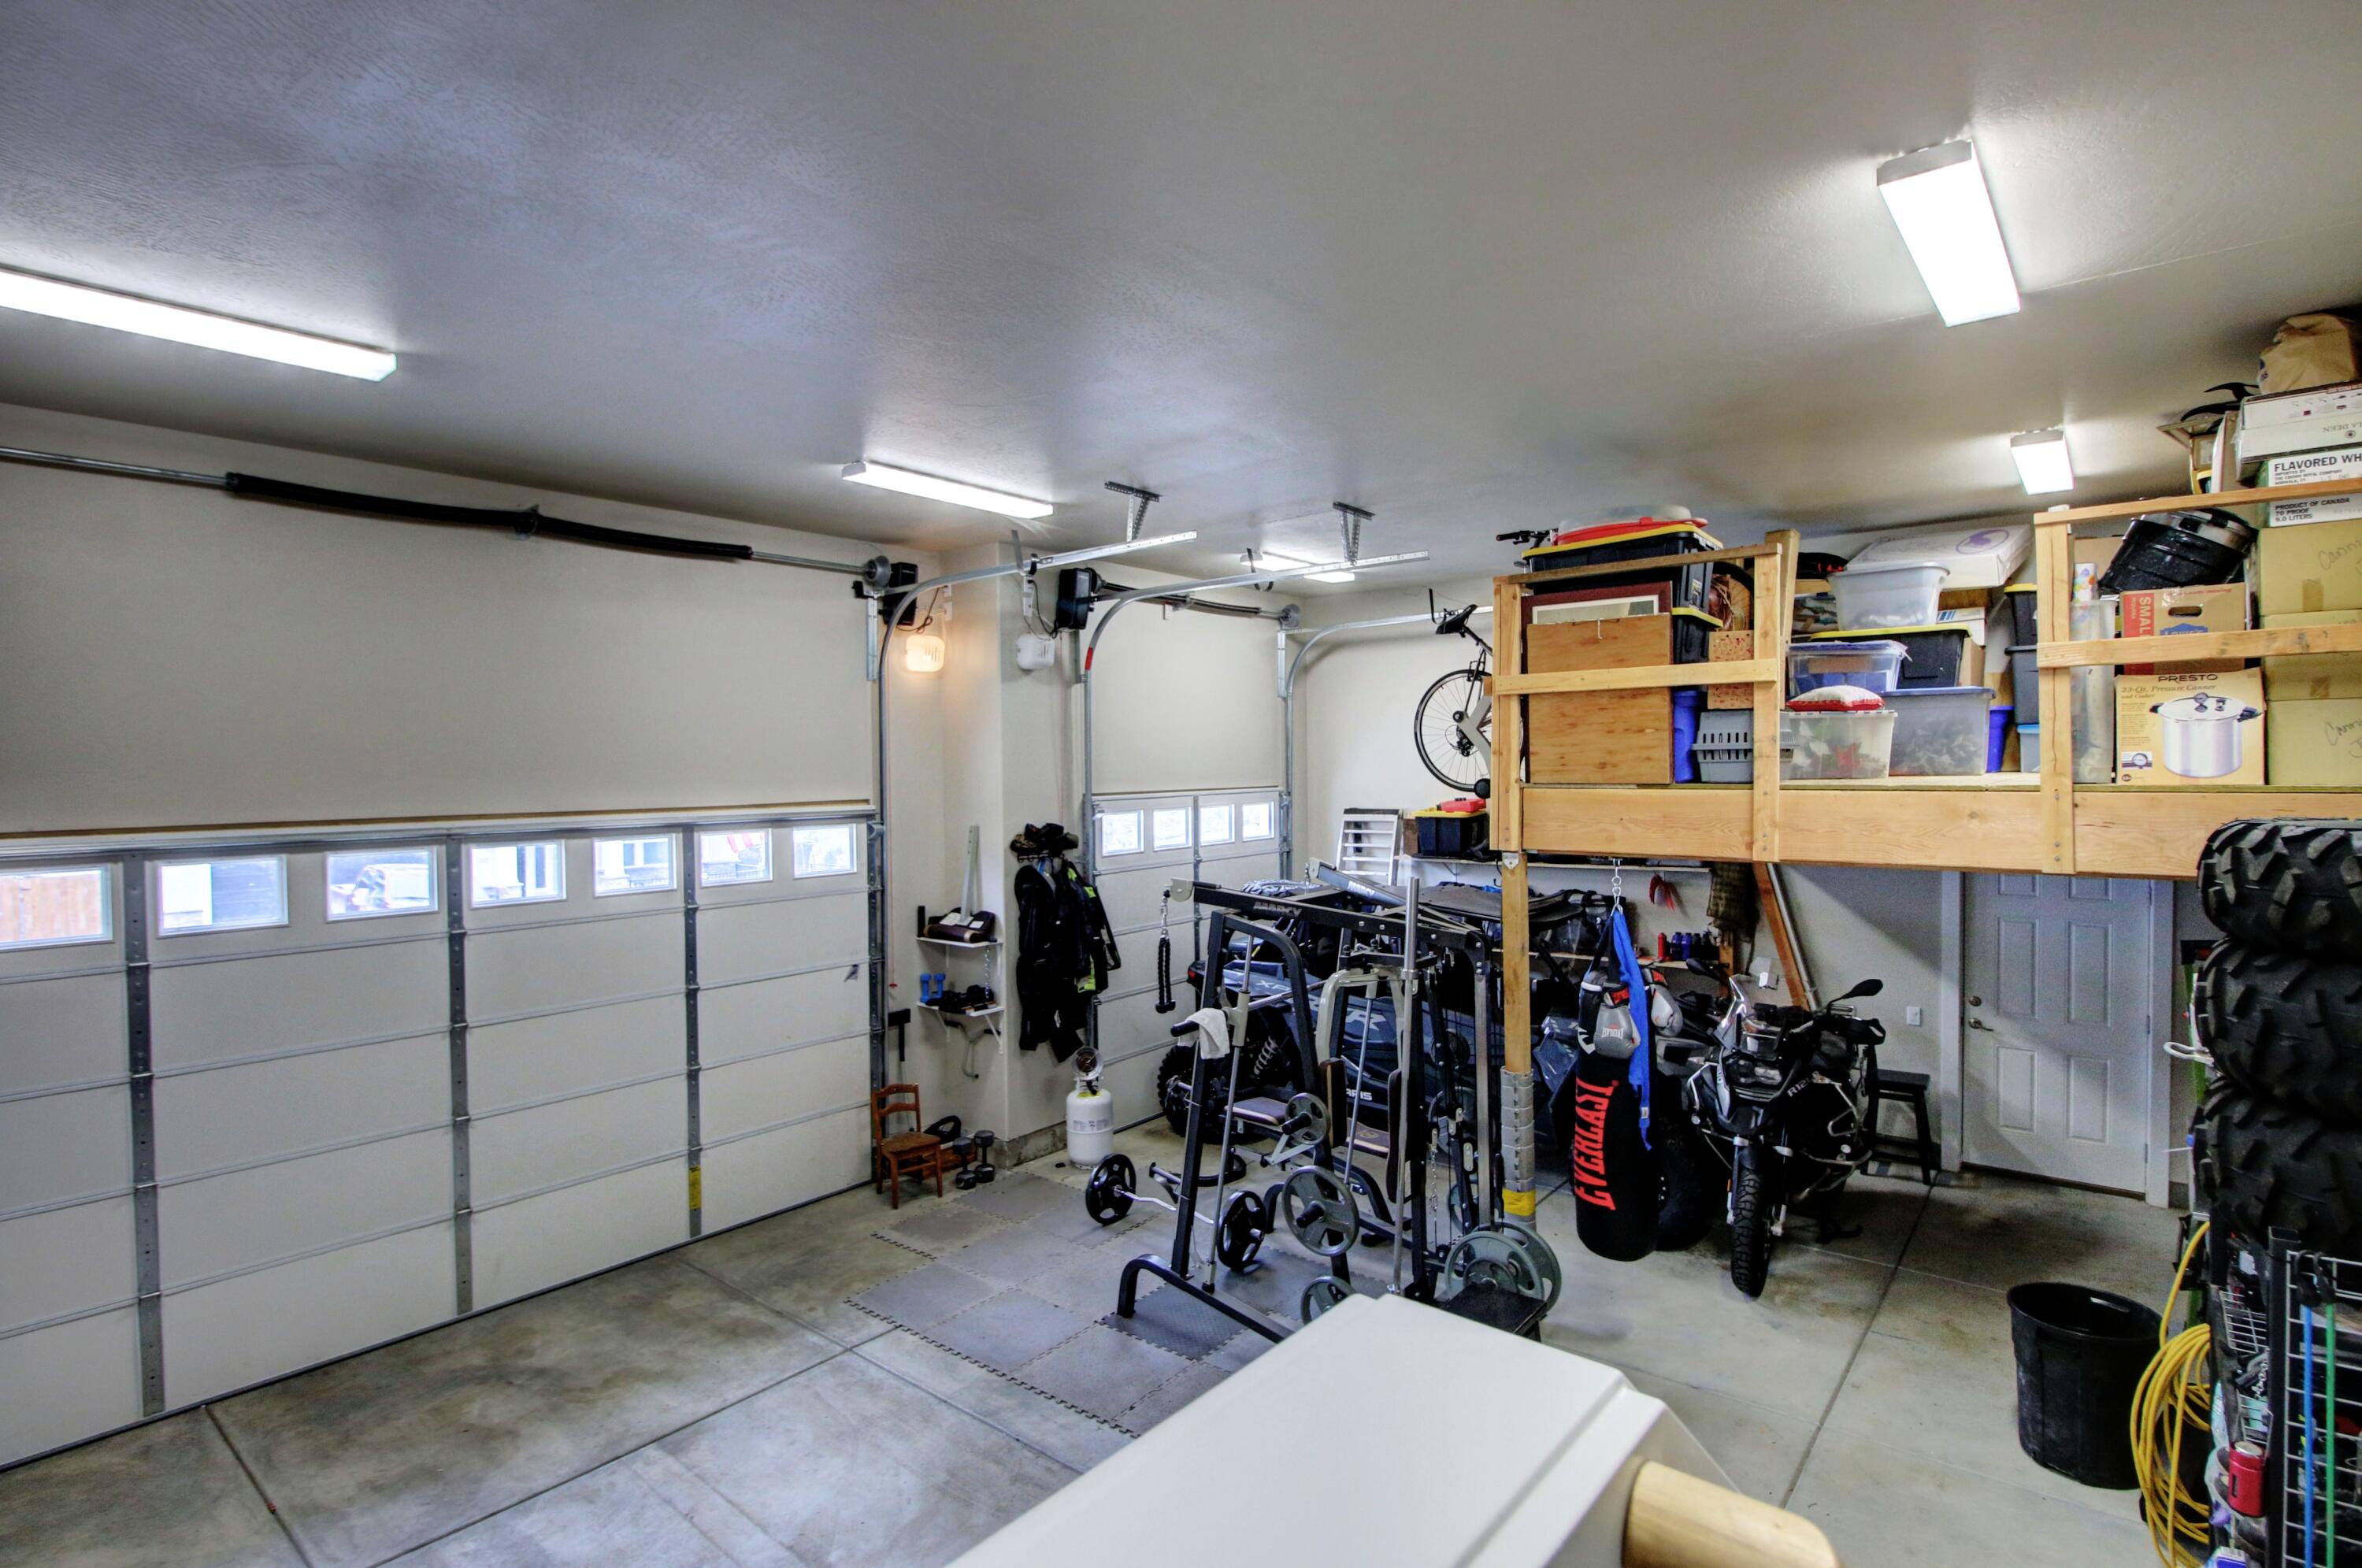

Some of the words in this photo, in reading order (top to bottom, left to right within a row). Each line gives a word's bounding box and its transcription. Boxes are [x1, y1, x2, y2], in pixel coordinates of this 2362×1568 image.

[2275, 456, 2338, 473] FLAVORED
[2275, 502, 2308, 511] PRODUCT
[2321, 497, 2350, 506] CANADA
[2158, 673, 2219, 684] PRESTO
[2151, 684, 2184, 693] Pressure
[1574, 1077, 1617, 1210] EVERLAST
